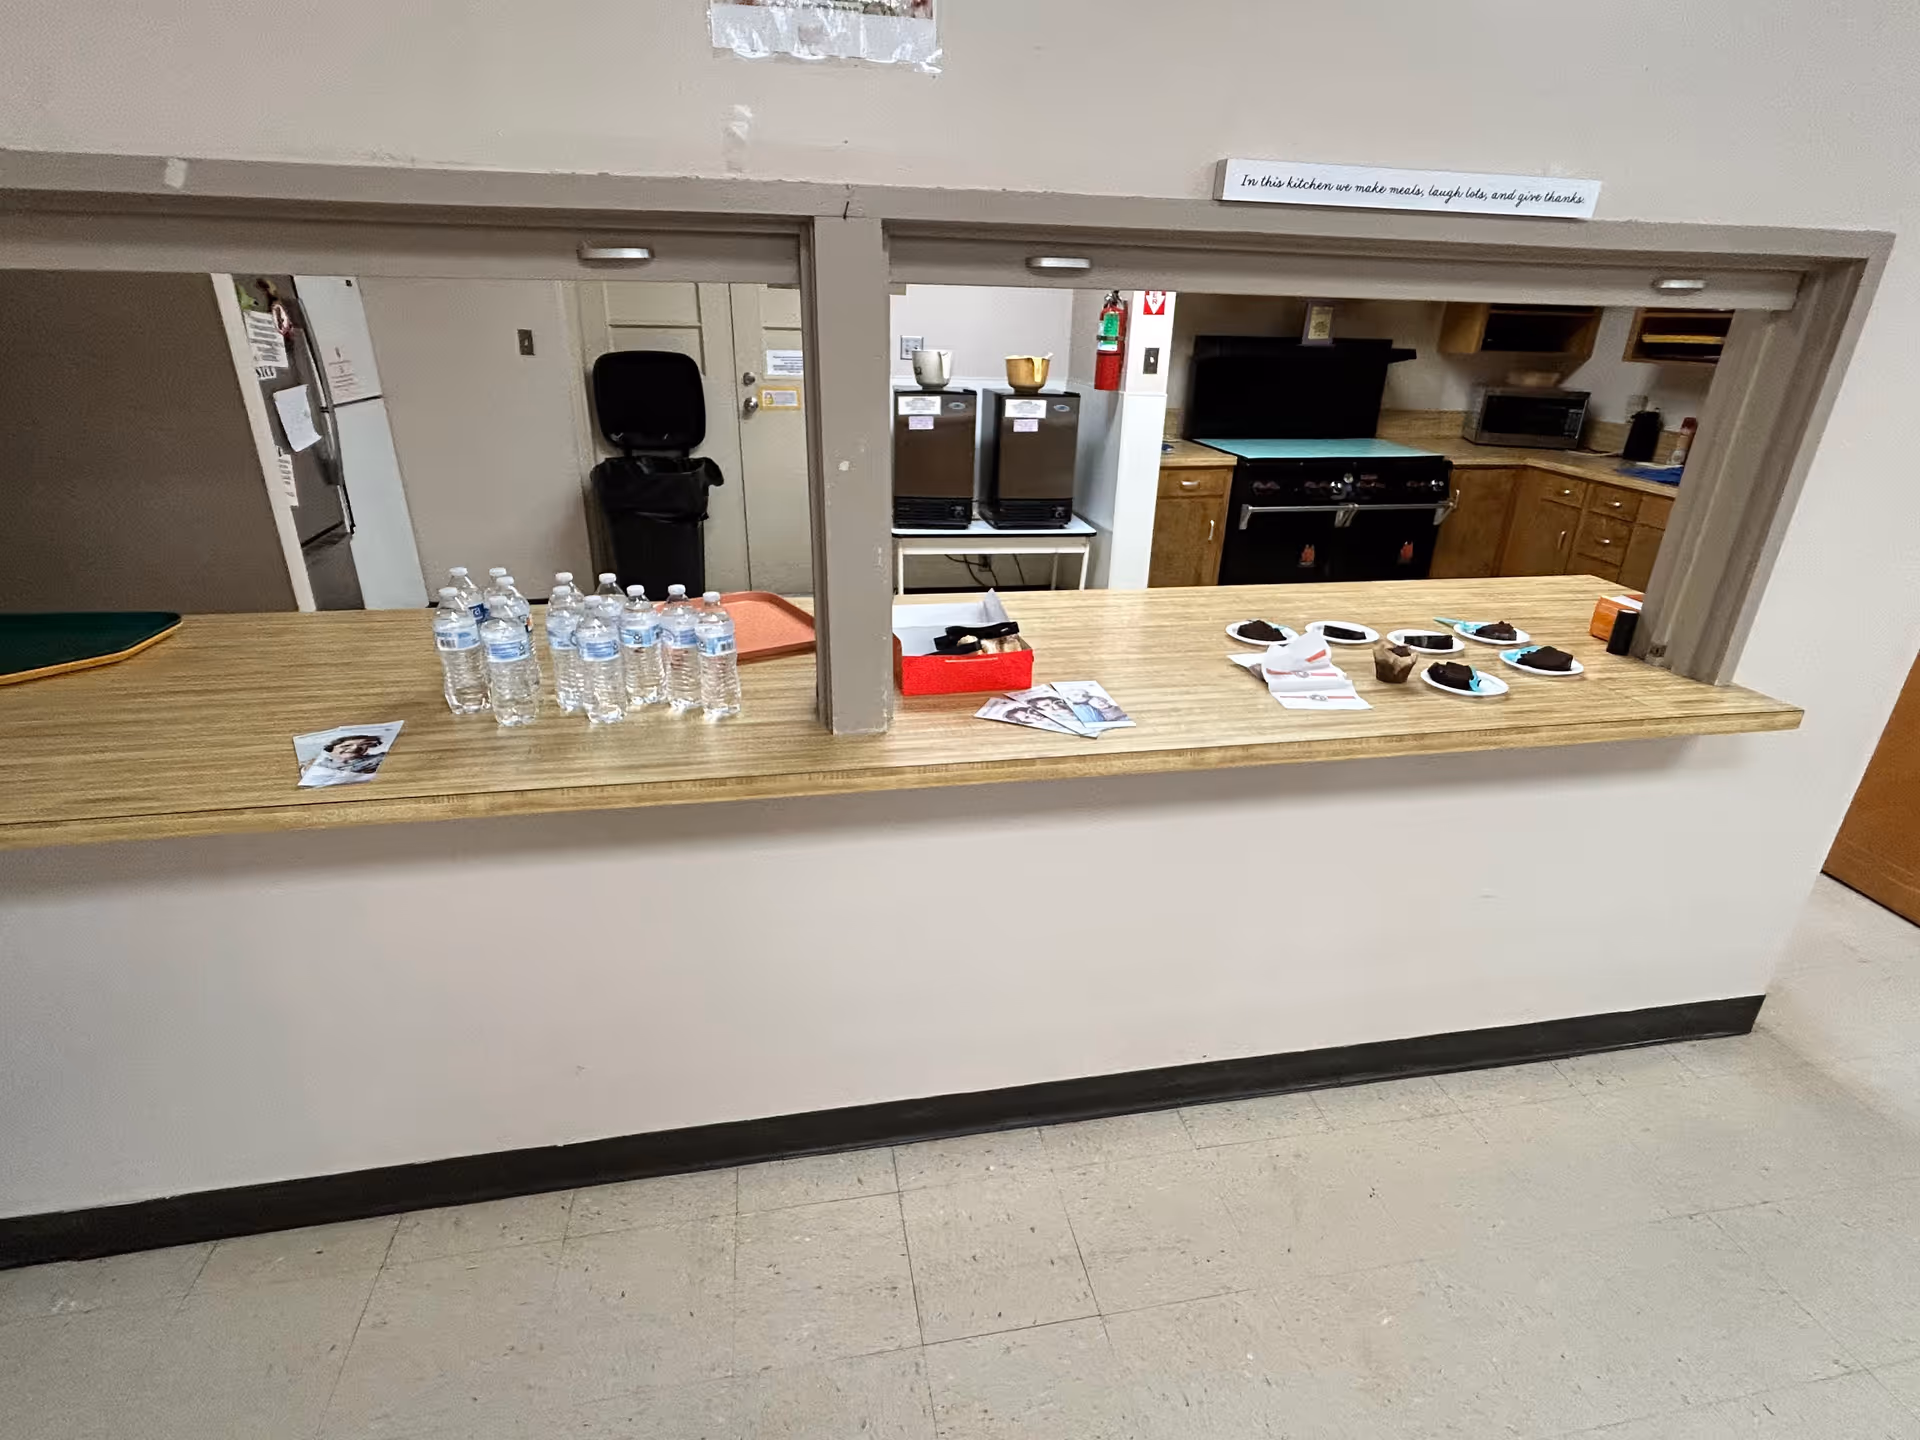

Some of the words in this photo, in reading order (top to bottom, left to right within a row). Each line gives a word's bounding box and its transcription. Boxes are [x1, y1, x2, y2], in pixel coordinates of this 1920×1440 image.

[1241, 174, 1258, 187] In
[1260, 175, 1284, 189] this
[1286, 176, 1334, 192] kitchen
[1335, 184, 1352, 193] we
[1354, 181, 1387, 195] make
[1389, 184, 1425, 198] meals,
[1428, 184, 1464, 204] laugh
[1465, 186, 1488, 201] lots,
[1490, 189, 1516, 202] and
[1515, 190, 1542, 208] give
[1543, 191, 1585, 204] thanks.
